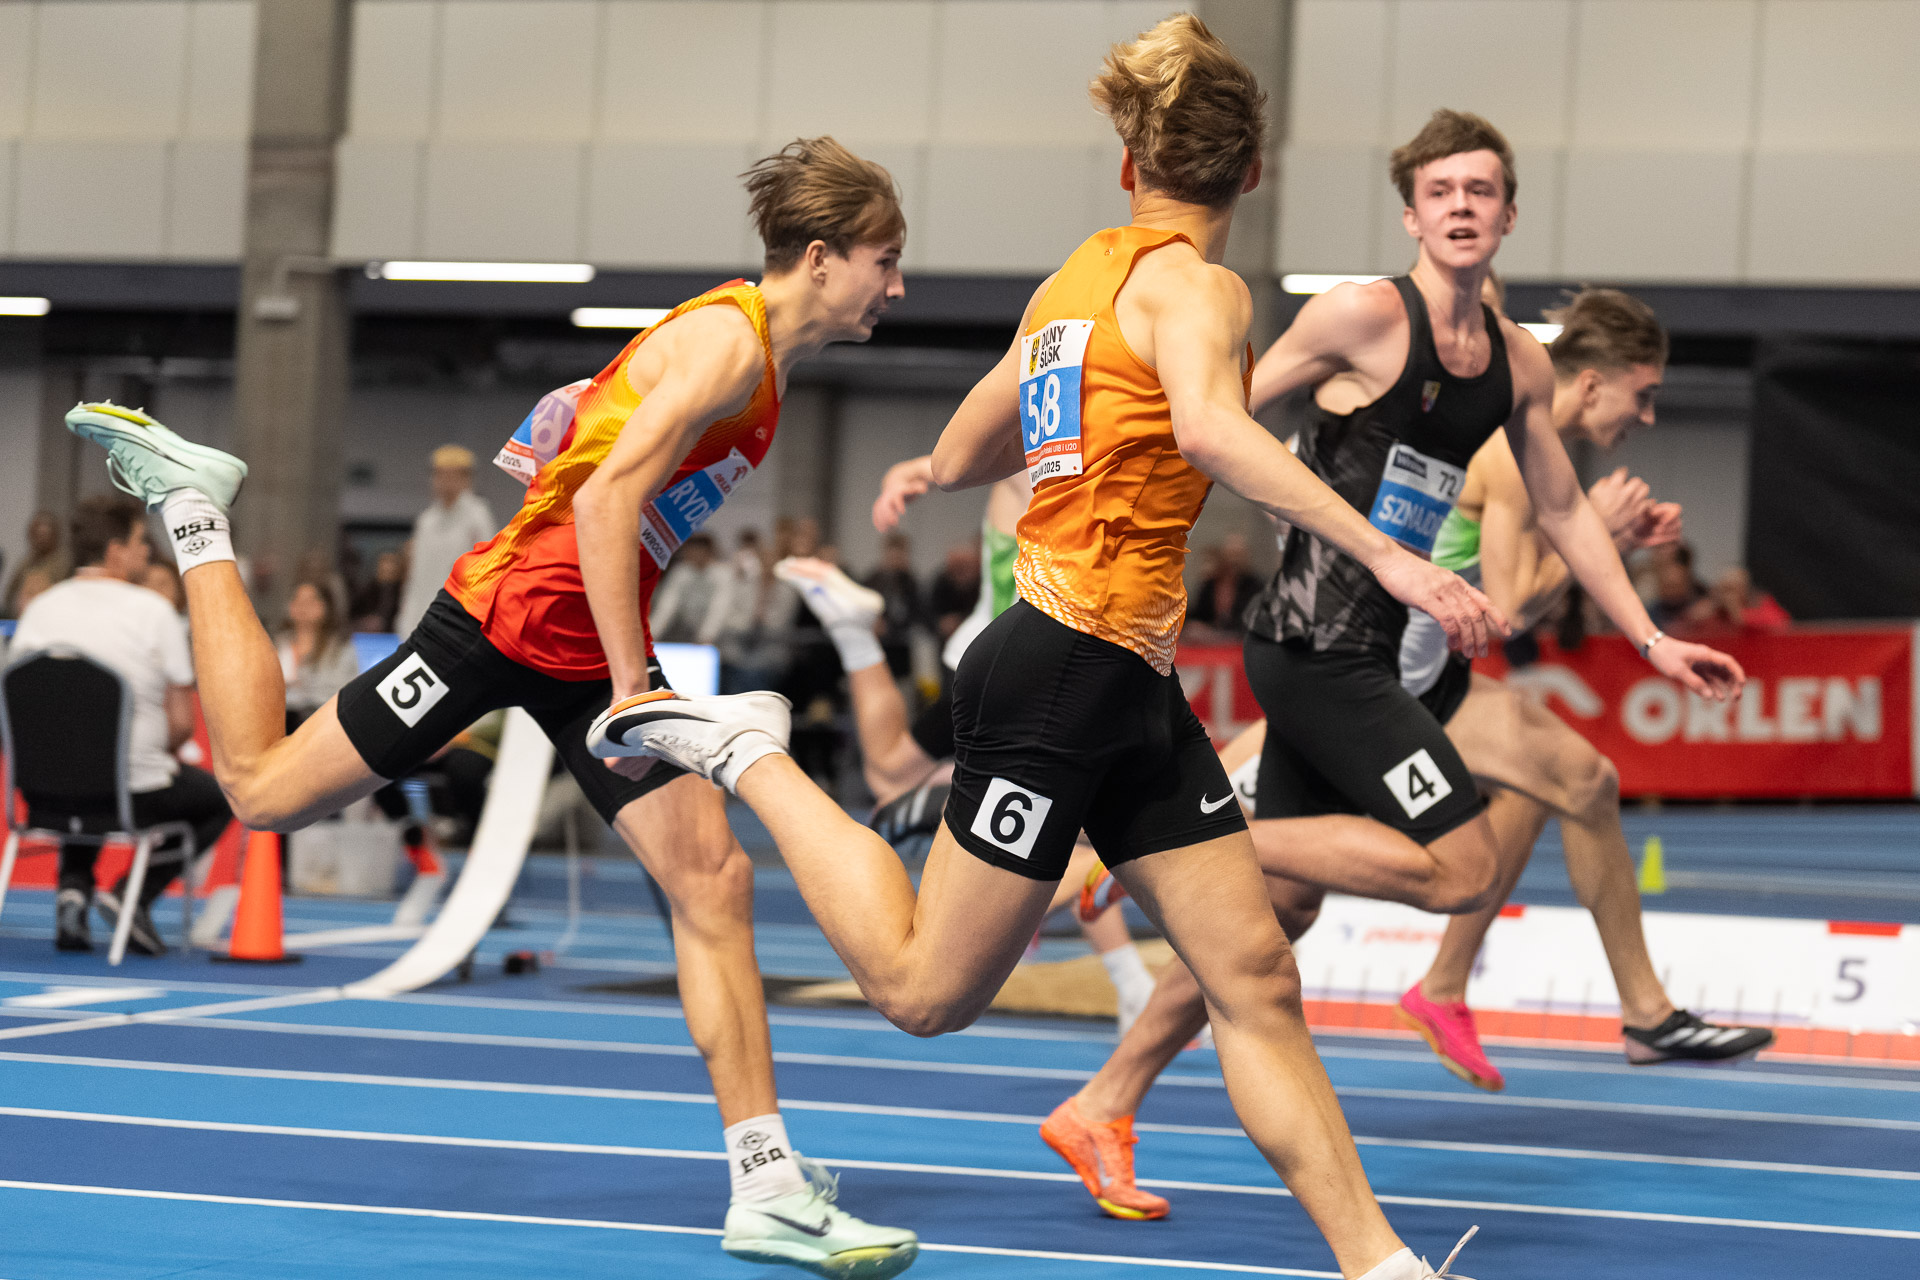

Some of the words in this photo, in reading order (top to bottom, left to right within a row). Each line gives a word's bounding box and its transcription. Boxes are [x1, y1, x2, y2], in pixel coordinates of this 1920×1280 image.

[1065, 443, 1078, 451] U20
[391, 666, 436, 710] 5
[1621, 675, 1884, 745] ORLEN
[1409, 763, 1436, 800] 4
[990, 791, 1033, 845] 6
[1832, 957, 1867, 1003] 5
